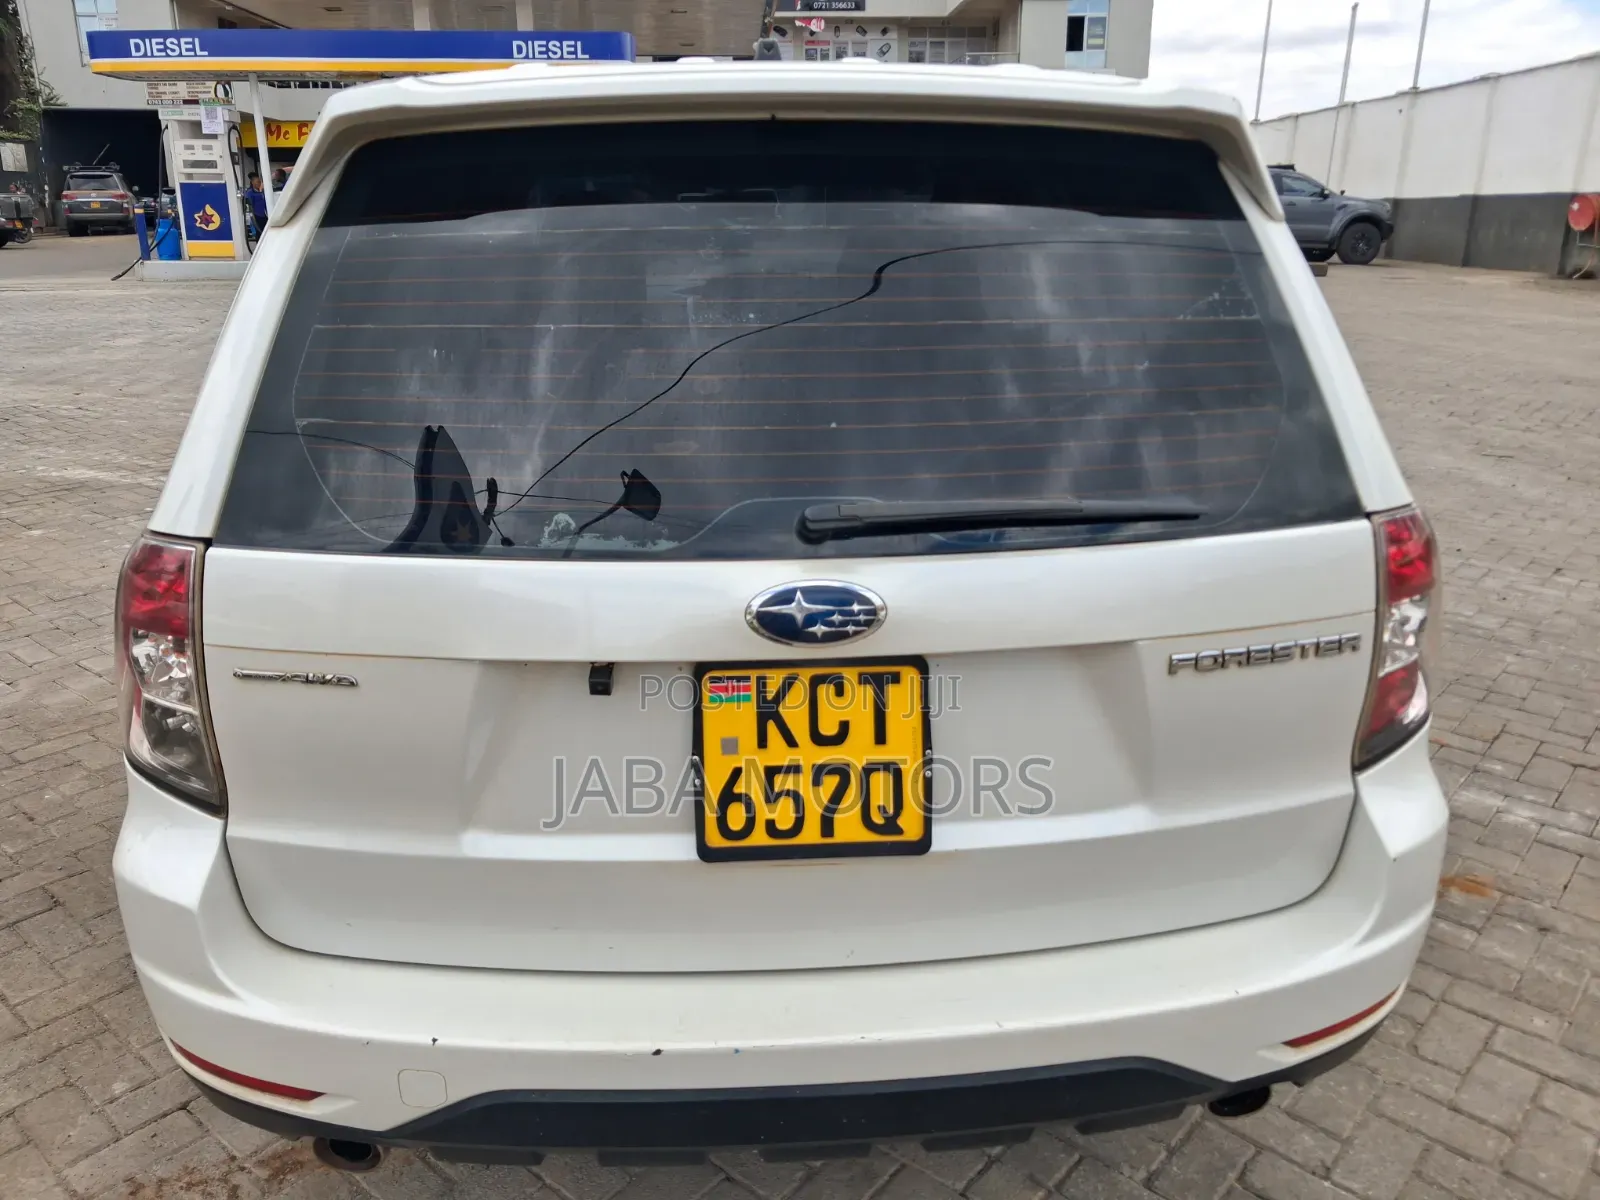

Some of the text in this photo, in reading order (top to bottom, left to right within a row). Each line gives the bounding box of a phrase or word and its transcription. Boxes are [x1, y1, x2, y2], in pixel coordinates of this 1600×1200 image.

[813, 1, 856, 9] 0721 356633
[129, 37, 209, 57] DIESEL
[512, 40, 590, 59] DIESEL
[266, 122, 291, 142] Mc
[1168, 632, 1361, 676] FORESTER
[755, 670, 902, 750] KCT
[715, 760, 905, 842] 657Q
